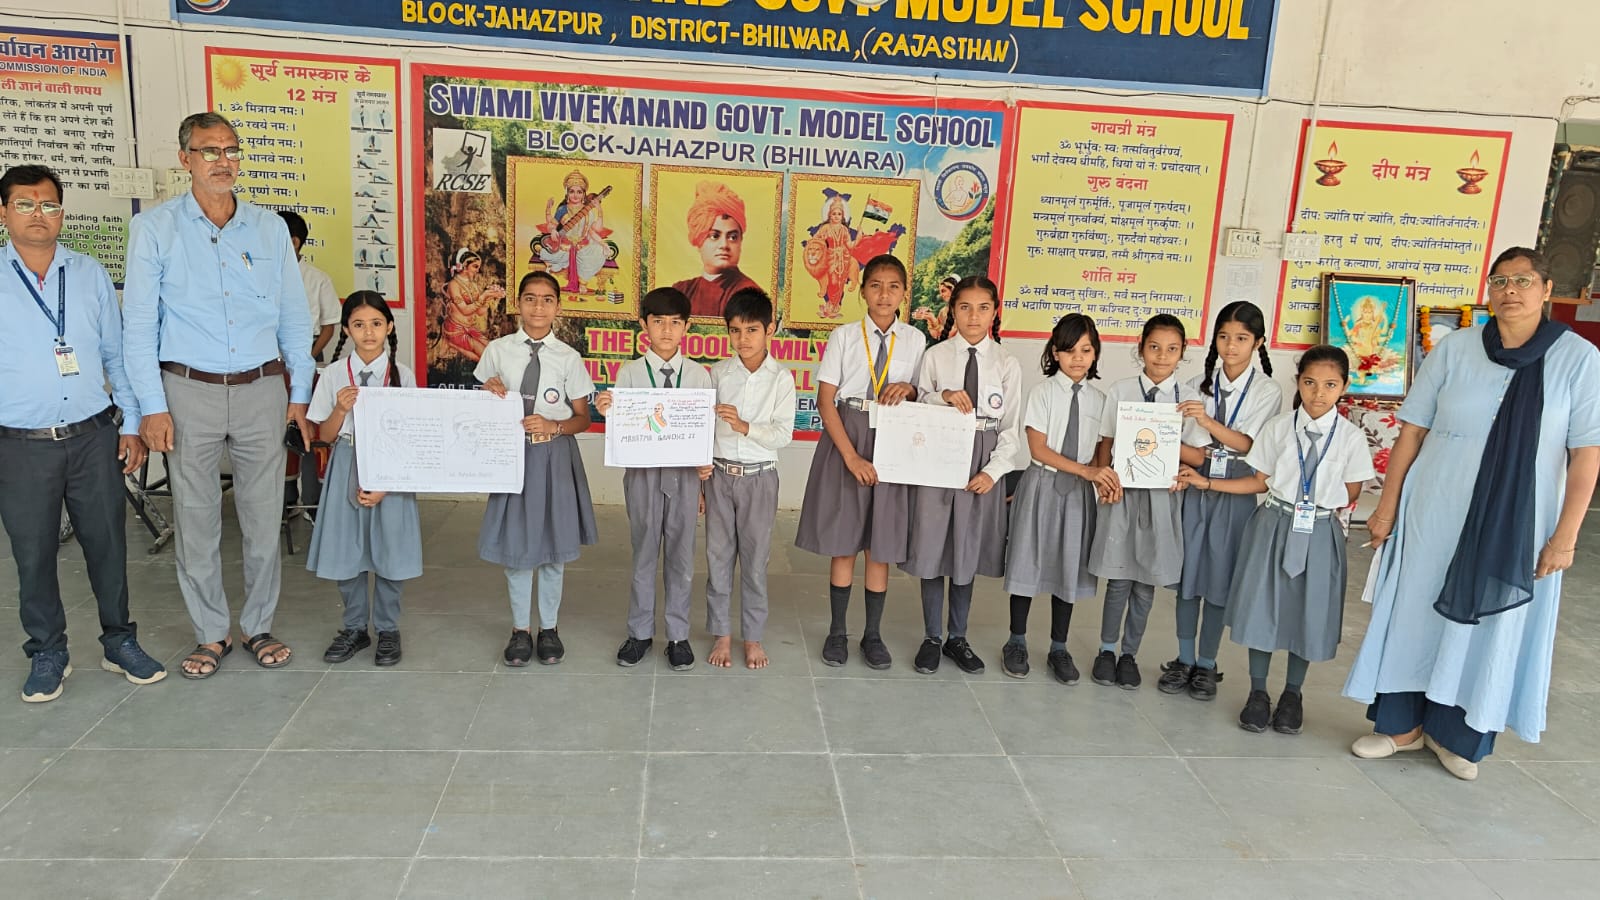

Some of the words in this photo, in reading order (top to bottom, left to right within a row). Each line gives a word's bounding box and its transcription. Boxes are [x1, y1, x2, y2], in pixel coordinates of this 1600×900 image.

[1079, 0, 1249, 40] SCHOOL
[52, 43, 115, 63] आयोग
[0, 62, 58, 73] OMMISSION
[62, 66, 75, 75] OF
[80, 68, 107, 77] INDIA
[250, 60, 279, 82] सूर्य
[283, 65, 348, 83] नमस्कार
[354, 66, 371, 83] के
[45, 81, 71, 94] वाली
[74, 85, 102, 96] शपथ
[287, 88, 306, 102] 12
[312, 86, 338, 103] मंत्र
[71, 102, 94, 112] अपनी
[97, 103, 113, 115] पूर्ण
[230, 102, 243, 111] ॐ
[246, 102, 276, 113] मित्राय
[29, 111, 42, 121] कि
[44, 114, 57, 123] हम
[60, 115, 80, 124] अपने
[83, 116, 98, 126] देश
[100, 117, 113, 126] की
[431, 84, 532, 119] SWAMI
[541, 90, 707, 129] VIVEKANAND
[716, 103, 792, 136] GOVT.
[800, 108, 888, 141] MODEL
[896, 114, 994, 148] SCHOOL
[230, 119, 243, 128] ॐ
[1091, 119, 1132, 135] गायत्री
[1136, 120, 1157, 137] मंत्र
[13, 124, 38, 135] मर्यादा
[44, 126, 56, 136] को
[63, 129, 86, 140] बनाए
[37, 138, 69, 150] निर्वाचन
[73, 141, 85, 150] की
[90, 143, 115, 152] गरिमा
[246, 134, 275, 149] सूर्याय
[1060, 139, 1071, 149] ॐ
[248, 152, 275, 163] भानवे
[527, 130, 755, 163] BLOCK-JAHAZPUR
[763, 144, 905, 176] (BHILWARA)
[1052, 153, 1077, 165] देवस्य
[1113, 157, 1133, 168] धियो
[1136, 158, 1146, 169] यो
[1148, 161, 1157, 170] नः
[248, 170, 278, 179] खगाय
[1372, 158, 1400, 181] दीप
[1405, 160, 1431, 181] मंत्र
[233, 184, 246, 194] ॐ
[435, 173, 492, 191] RCSE
[1087, 175, 1112, 192] गुरु
[1116, 173, 1148, 191] वंदना
[1119, 200, 1152, 212] पूजामूलं
[65, 214, 98, 223] abiding
[102, 214, 123, 223] faith
[1324, 209, 1350, 221] ज्योति
[67, 223, 100, 231] uphold
[75, 232, 90, 240] the
[93, 234, 123, 243] dignity
[1323, 234, 1343, 248] हरतु
[116, 243, 124, 251] in
[1047, 247, 1076, 259] साक्षात्
[98, 253, 124, 262] being
[1082, 266, 1113, 282] शांति
[1117, 267, 1137, 284] मंत्र
[1423, 262, 1441, 275] सुख
[1019, 285, 1031, 295] ॐ
[1051, 288, 1075, 300] भवन्तु
[1131, 292, 1147, 304] सन्तु
[1022, 299, 1051, 311] भद्राणि
[1087, 304, 1097, 312] मा
[588, 330, 632, 353] THE
[639, 331, 733, 358] SHOOL
[770, 339, 828, 361] MILY
